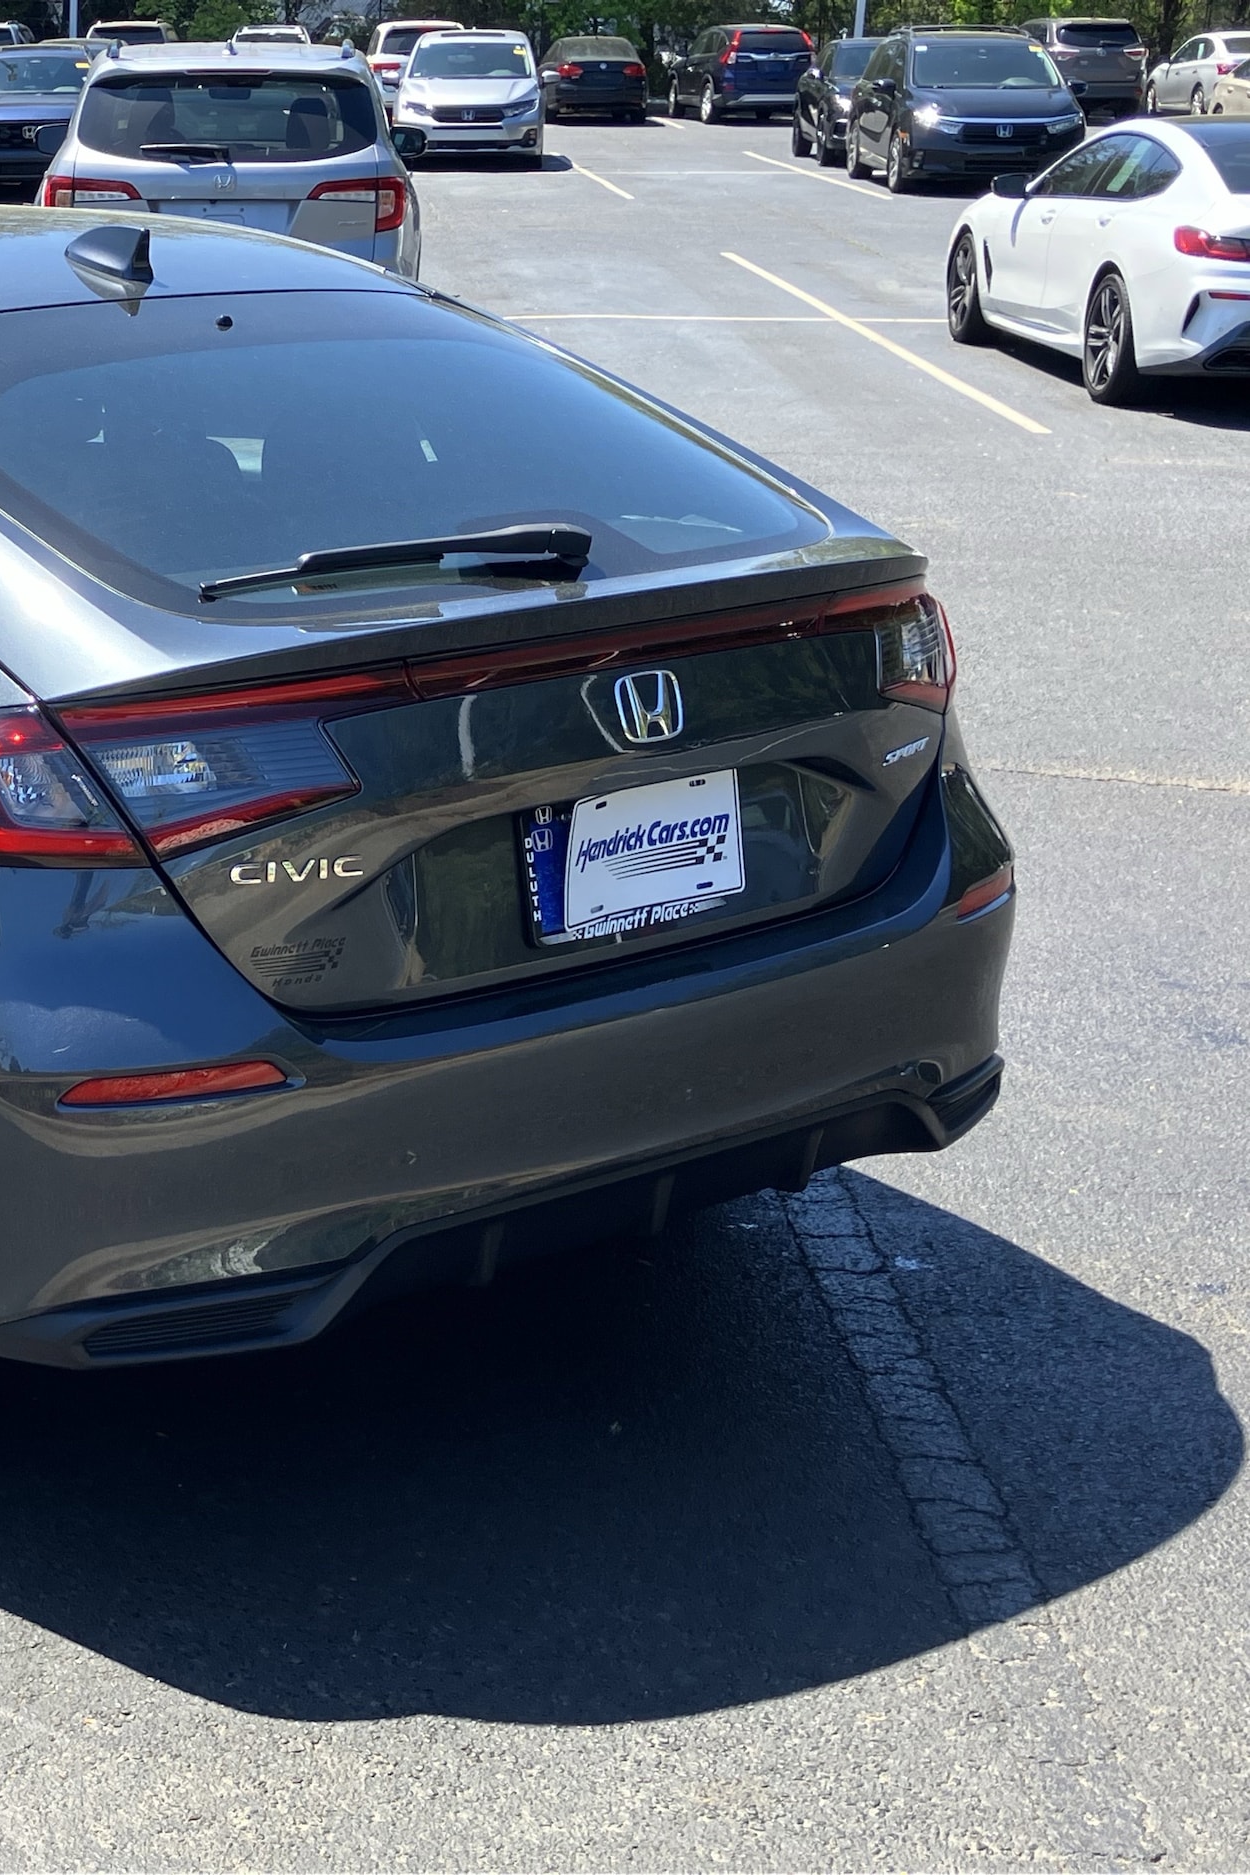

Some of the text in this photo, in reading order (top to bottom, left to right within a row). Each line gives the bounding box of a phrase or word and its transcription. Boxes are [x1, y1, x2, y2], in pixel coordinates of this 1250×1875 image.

[230, 854, 364, 885] CIVIC
[524, 837, 543, 922] DULUTH
[583, 902, 689, 939] Gwinnett Place
[250, 937, 347, 958] Gwinnett Place
[271, 973, 323, 988] Honda
